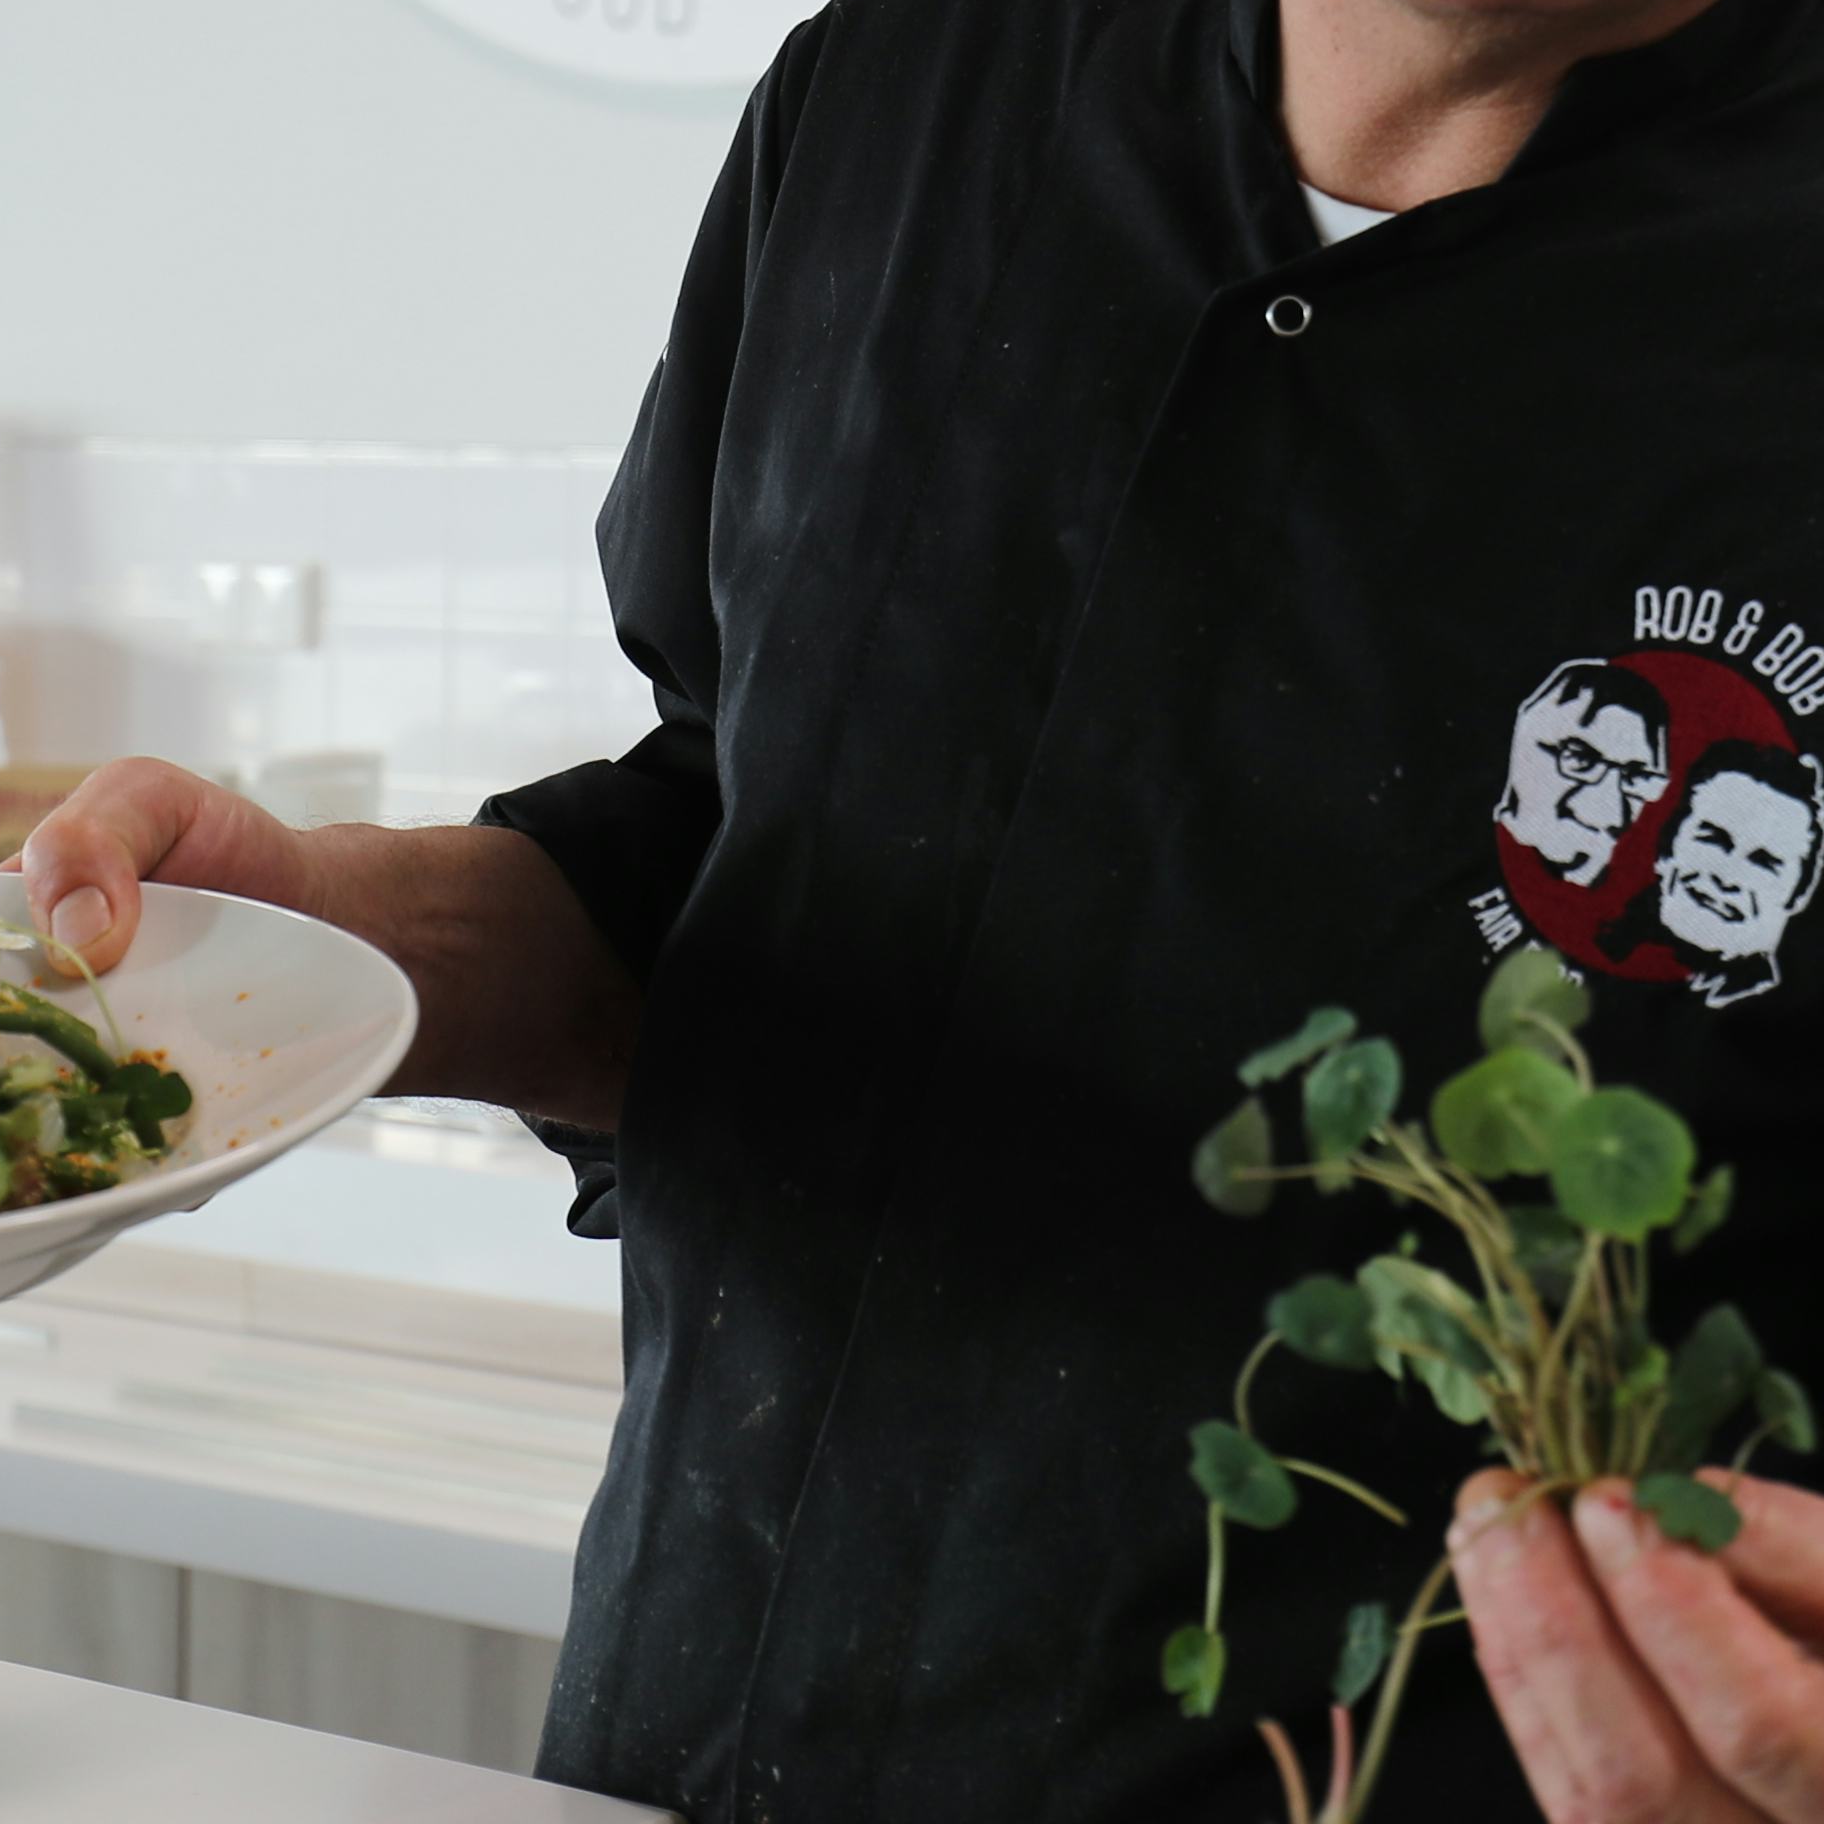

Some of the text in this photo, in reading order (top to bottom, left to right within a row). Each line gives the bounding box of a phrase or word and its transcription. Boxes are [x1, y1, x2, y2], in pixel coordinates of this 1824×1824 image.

[1633, 585, 1724, 645] ROB
[1722, 599, 1765, 656] &
[1467, 886, 1523, 954] FAIR
